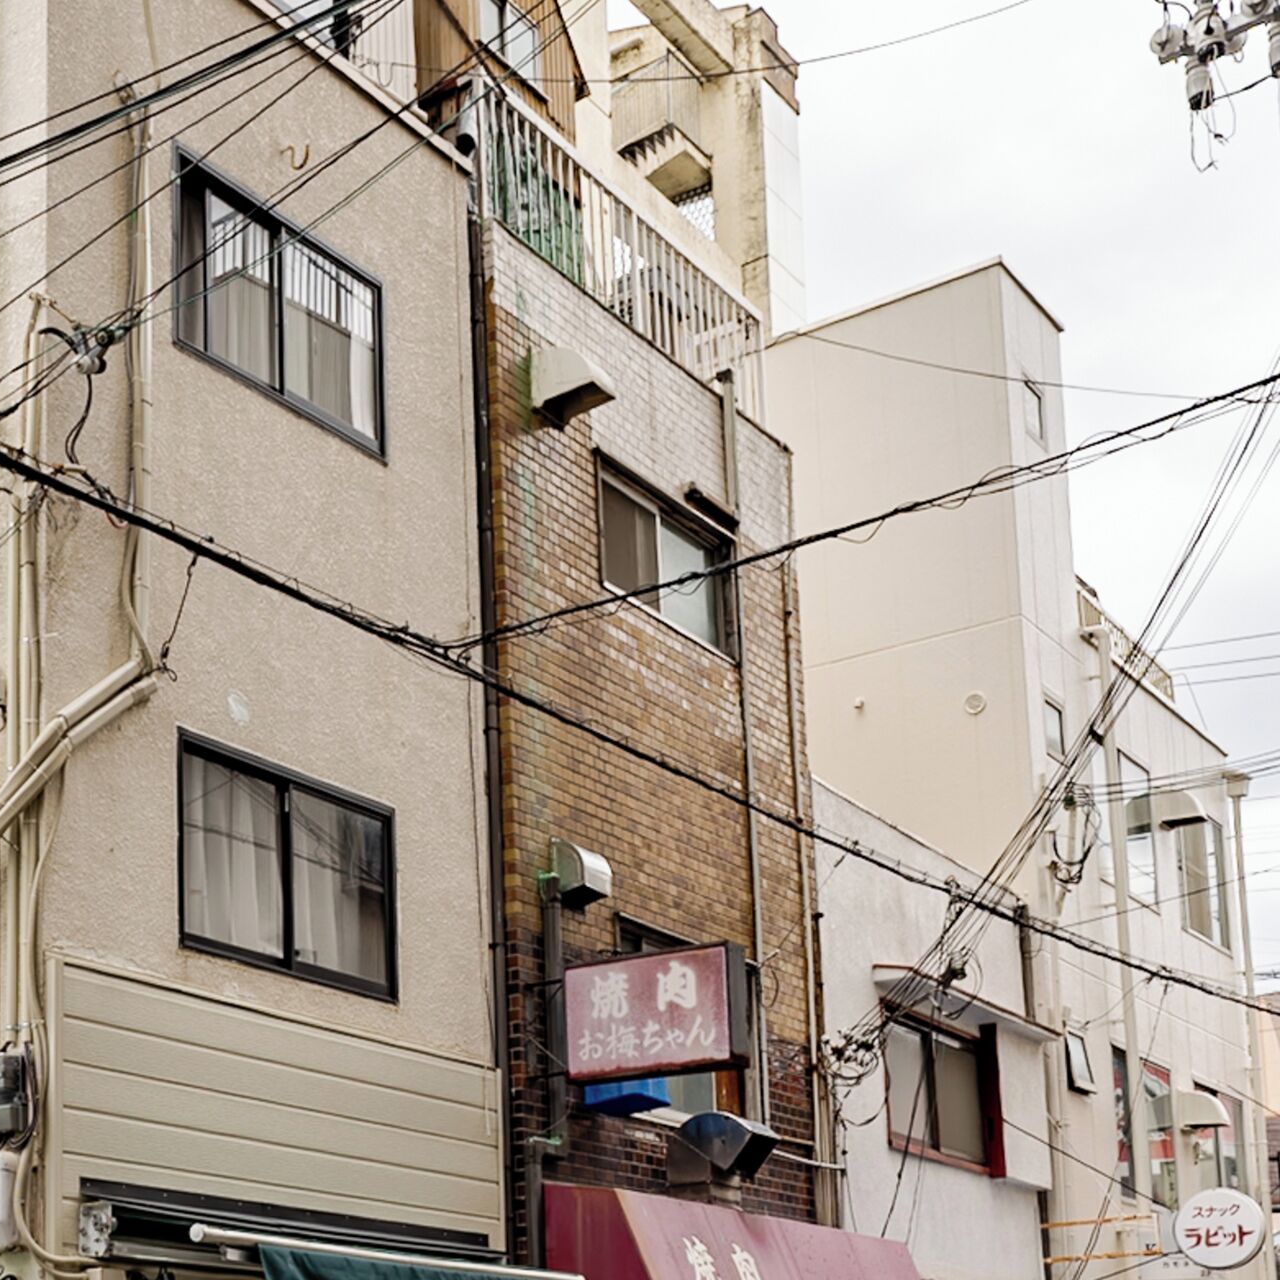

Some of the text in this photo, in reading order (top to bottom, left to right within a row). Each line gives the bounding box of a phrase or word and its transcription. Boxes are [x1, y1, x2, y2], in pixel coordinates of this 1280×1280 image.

[590, 959, 697, 1019] 焼肉
[578, 1014, 718, 1061] お梅ちゃん
[1192, 1203, 1240, 1219] スナック
[1184, 1224, 1255, 1250] ラビット
